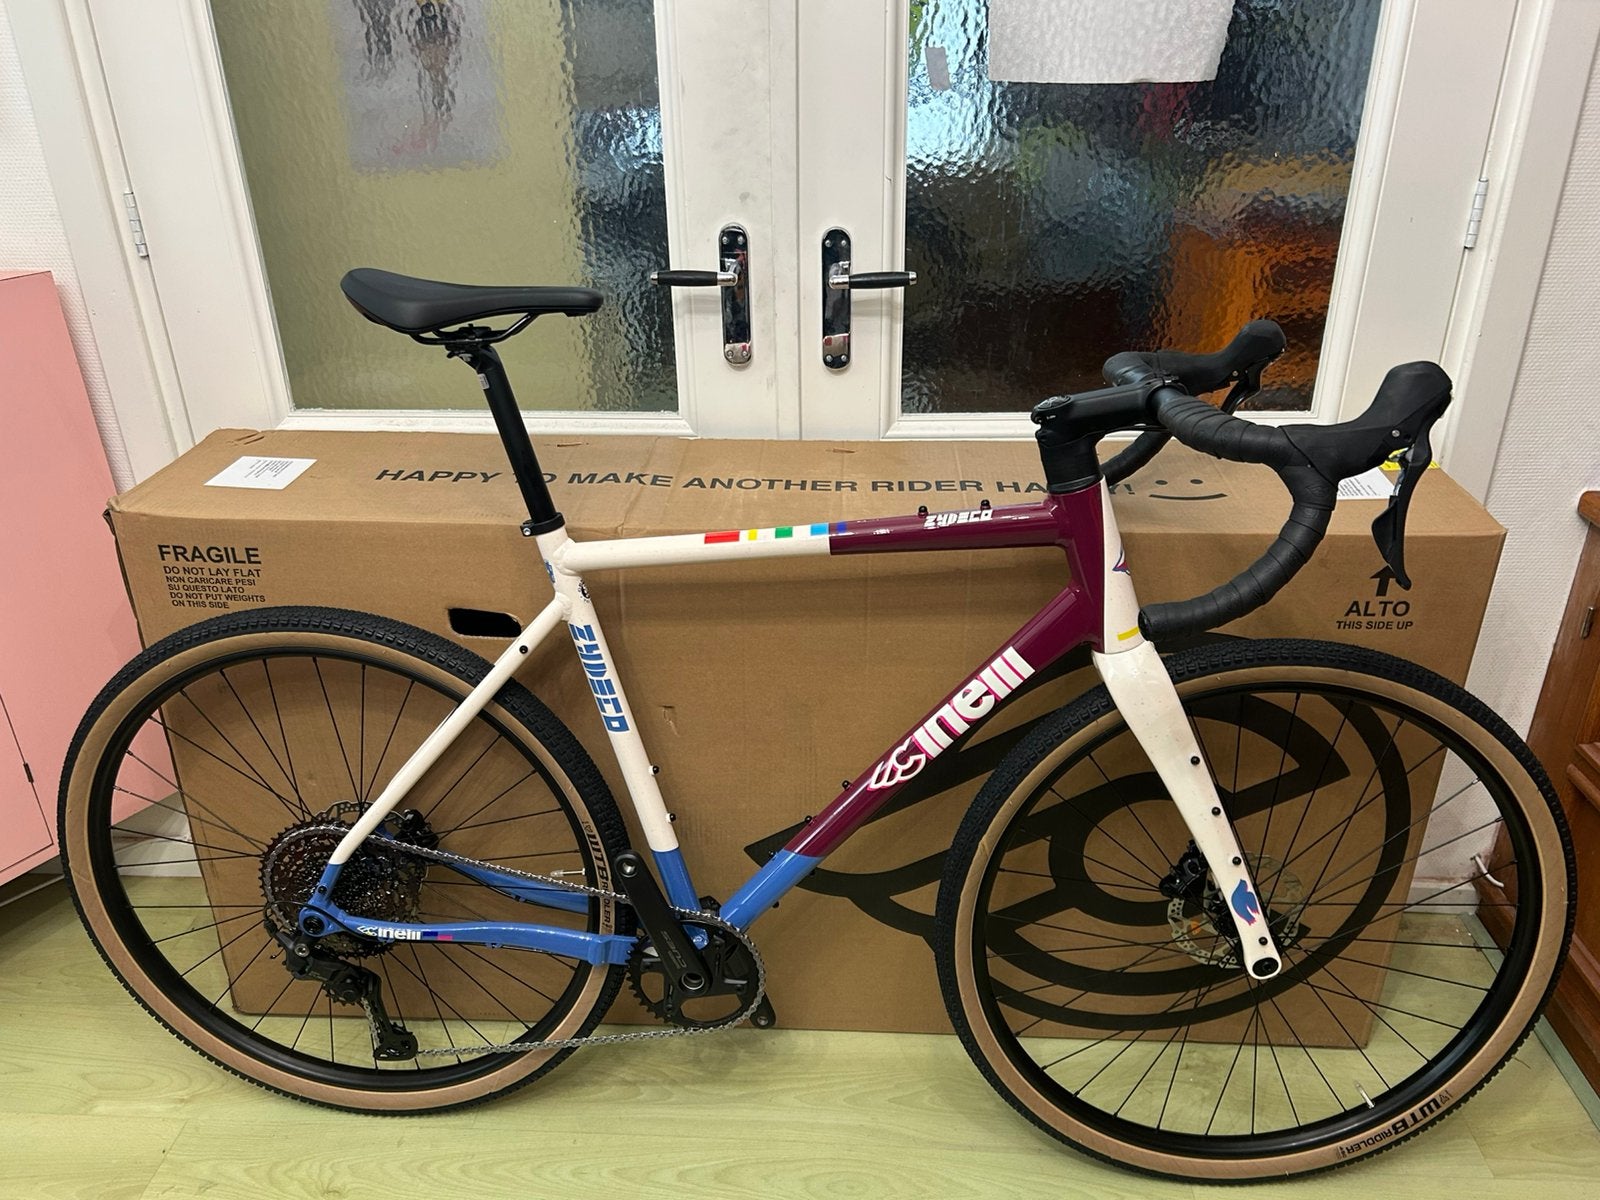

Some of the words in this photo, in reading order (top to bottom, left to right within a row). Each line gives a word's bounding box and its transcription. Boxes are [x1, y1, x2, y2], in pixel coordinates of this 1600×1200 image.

[375, 469, 503, 483] HAPPY
[568, 472, 674, 488] MAKE
[682, 477, 859, 491] ANOTHER
[871, 480, 984, 492] RIDER
[996, 481, 1136, 495] HAY!
[157, 544, 262, 565] FRAGILE
[163, 566, 180, 574] DO
[183, 567, 205, 576] NOT
[208, 568, 230, 576] LAY
[233, 568, 262, 577] FLAT
[182, 585, 219, 593] QUESTO
[187, 577, 233, 585] CARICARE
[235, 578, 256, 586] PESI
[224, 594, 266, 603] WEIGHTS
[1344, 600, 1410, 617] ALTO
[1336, 621, 1363, 630] THIS
[1365, 621, 1394, 630] SIDE
[1396, 621, 1414, 630] UP
[601, 881, 612, 925] RIDLER
[1392, 1098, 1442, 1136] WTB
[1346, 1129, 1393, 1154] RIDDLER
